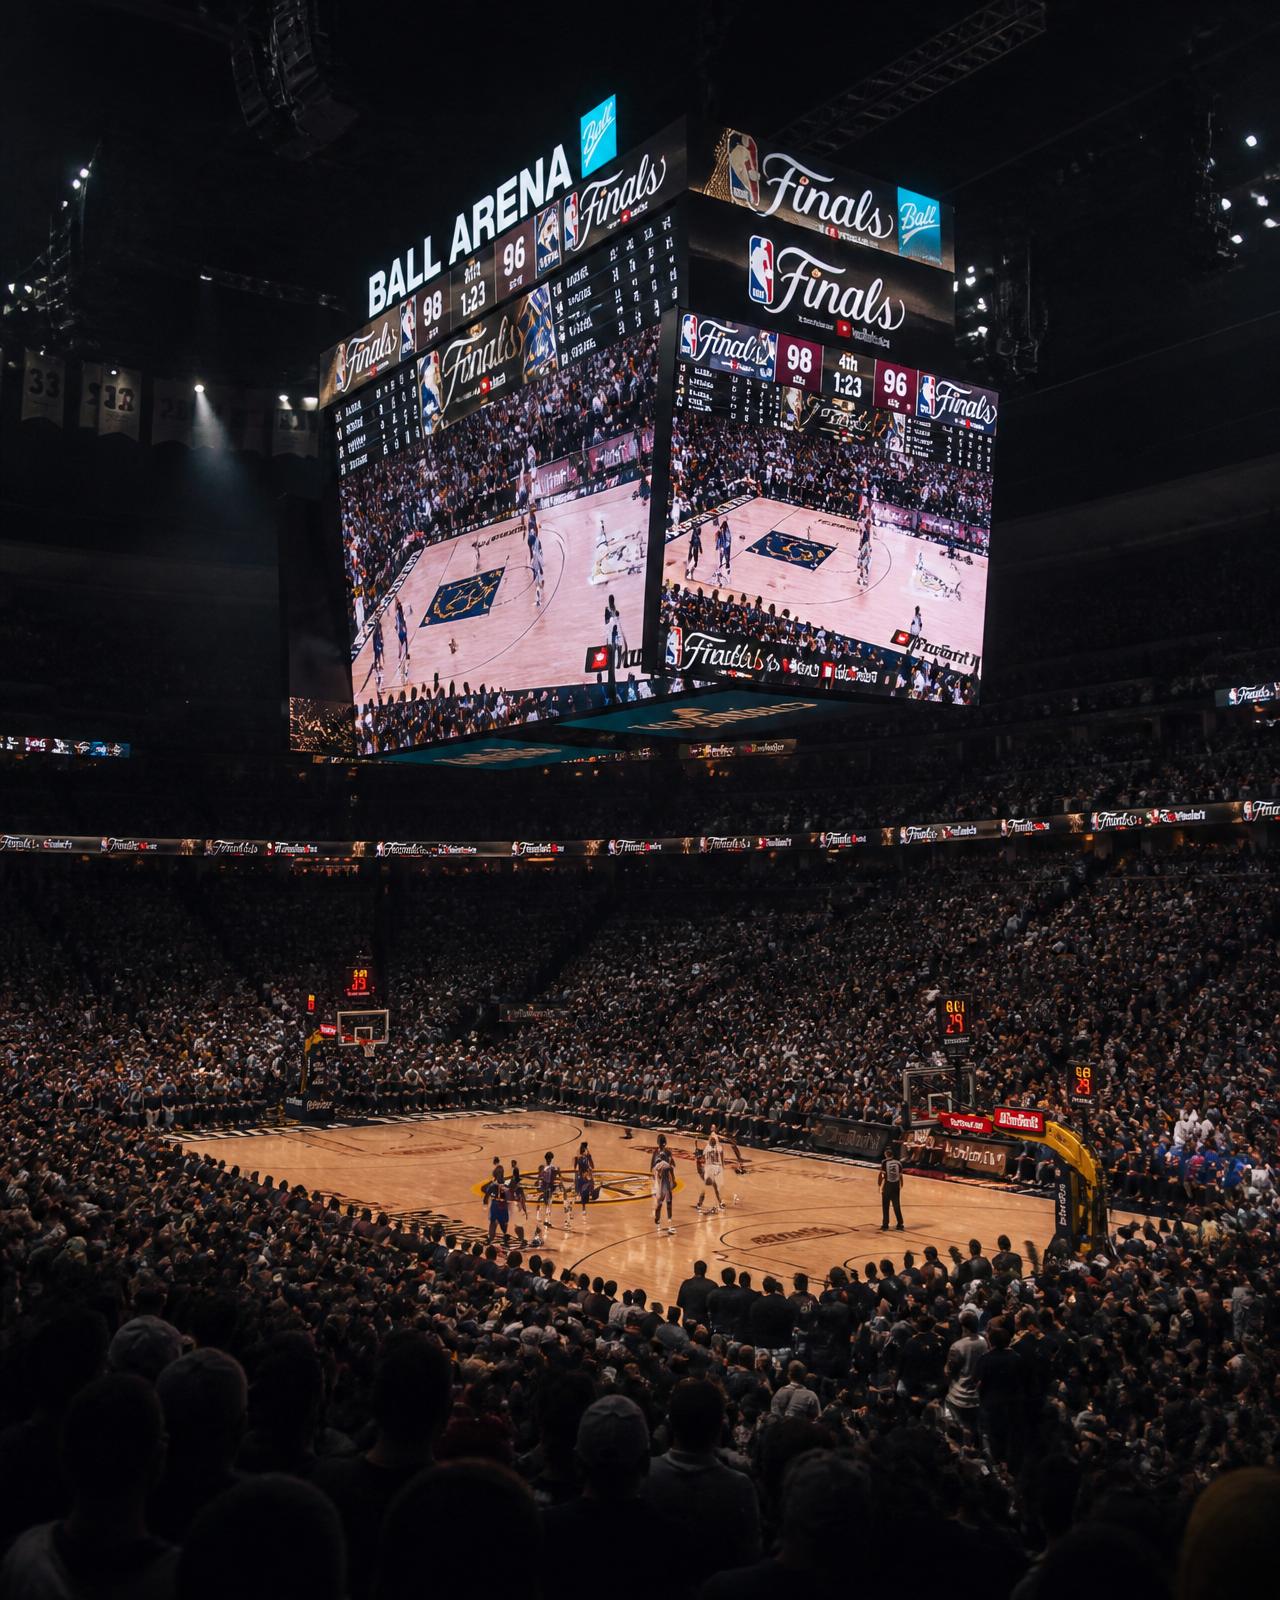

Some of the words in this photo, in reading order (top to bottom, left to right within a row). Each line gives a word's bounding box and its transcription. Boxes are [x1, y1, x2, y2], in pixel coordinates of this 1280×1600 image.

[583, 102, 615, 168] Ball
[571, 154, 666, 252] Finals
[748, 152, 894, 240] Finals
[368, 235, 442, 318] BALL
[449, 143, 573, 265] ARENA
[900, 202, 940, 245] Ball
[503, 235, 526, 277] 96
[422, 289, 443, 328] 98
[460, 280, 487, 318] 1:23
[763, 246, 905, 331] Finals
[787, 344, 813, 373] 98
[833, 371, 863, 399] 1:23
[883, 369, 908, 398] 96
[931, 380, 998, 425] Finals
